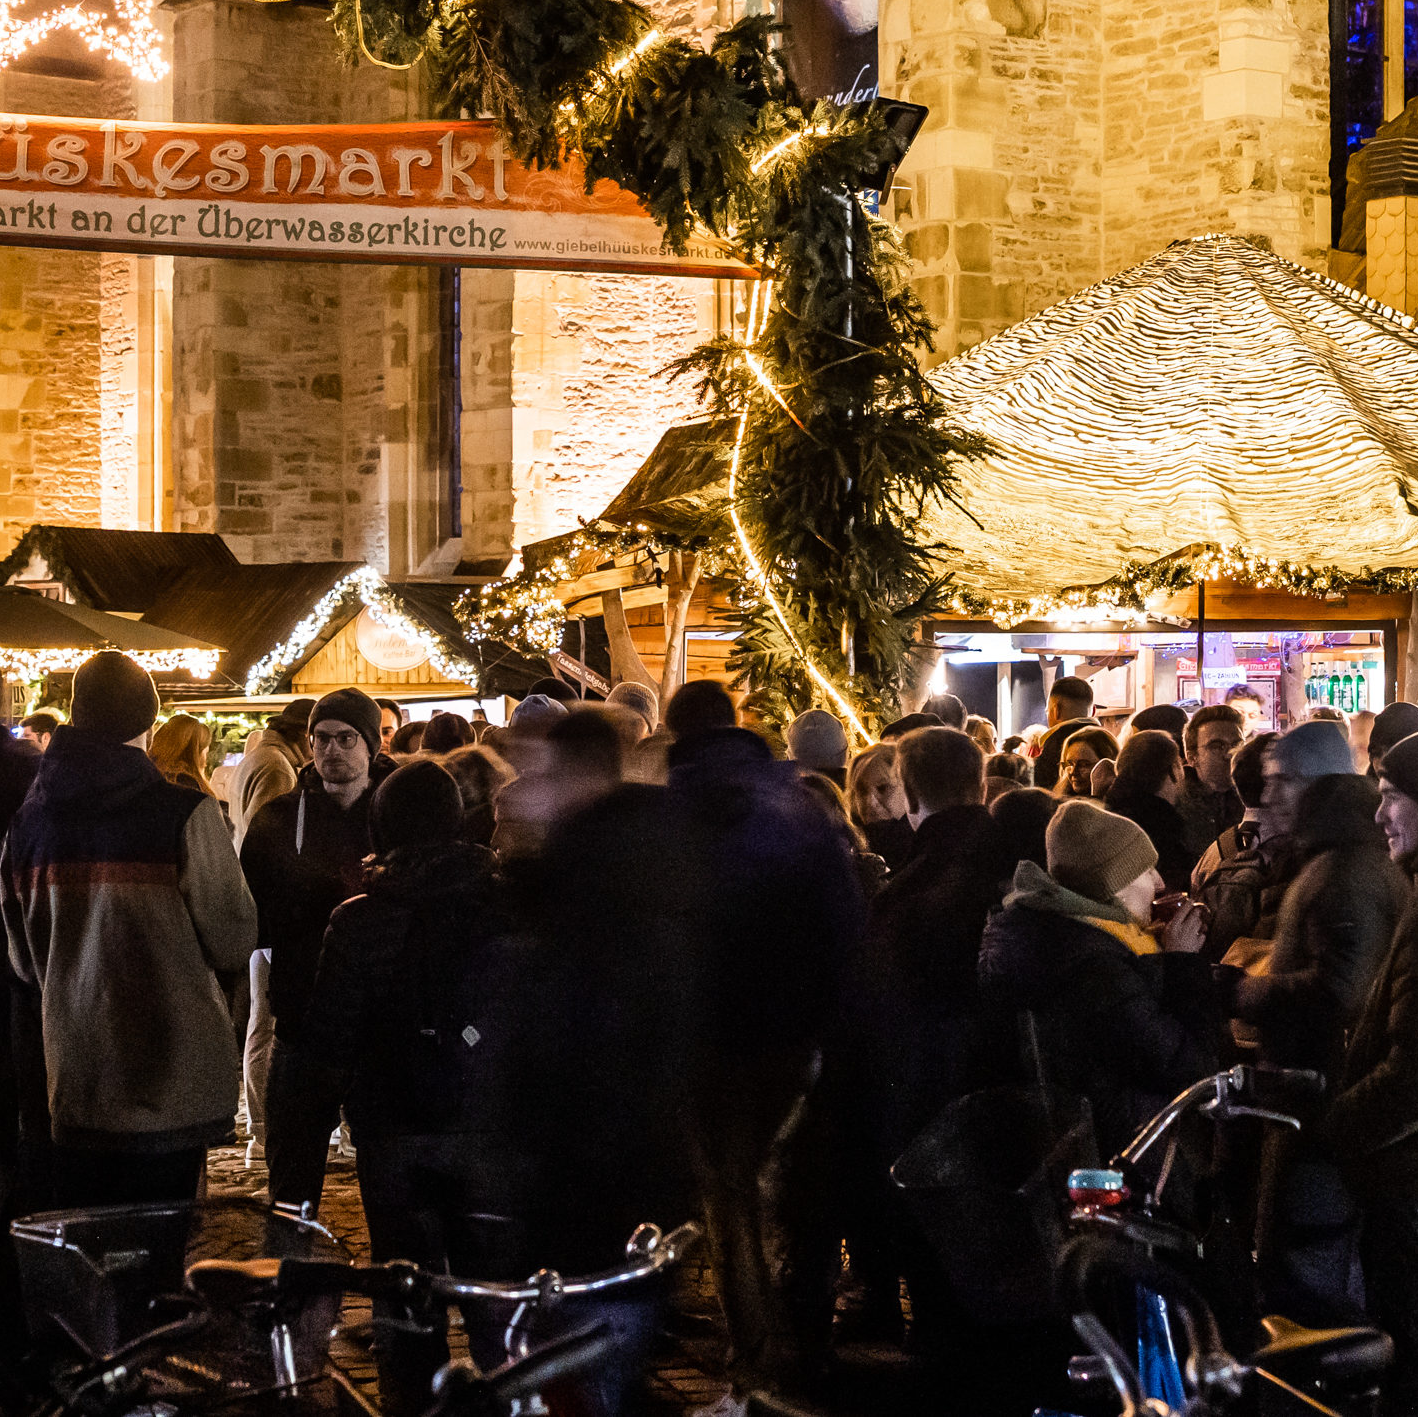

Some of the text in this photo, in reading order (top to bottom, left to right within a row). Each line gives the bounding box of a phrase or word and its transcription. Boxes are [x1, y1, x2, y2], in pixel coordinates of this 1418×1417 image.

[72, 209, 112, 233] an
[127, 205, 186, 238] der
[198, 204, 507, 251] Überwasserkirche
